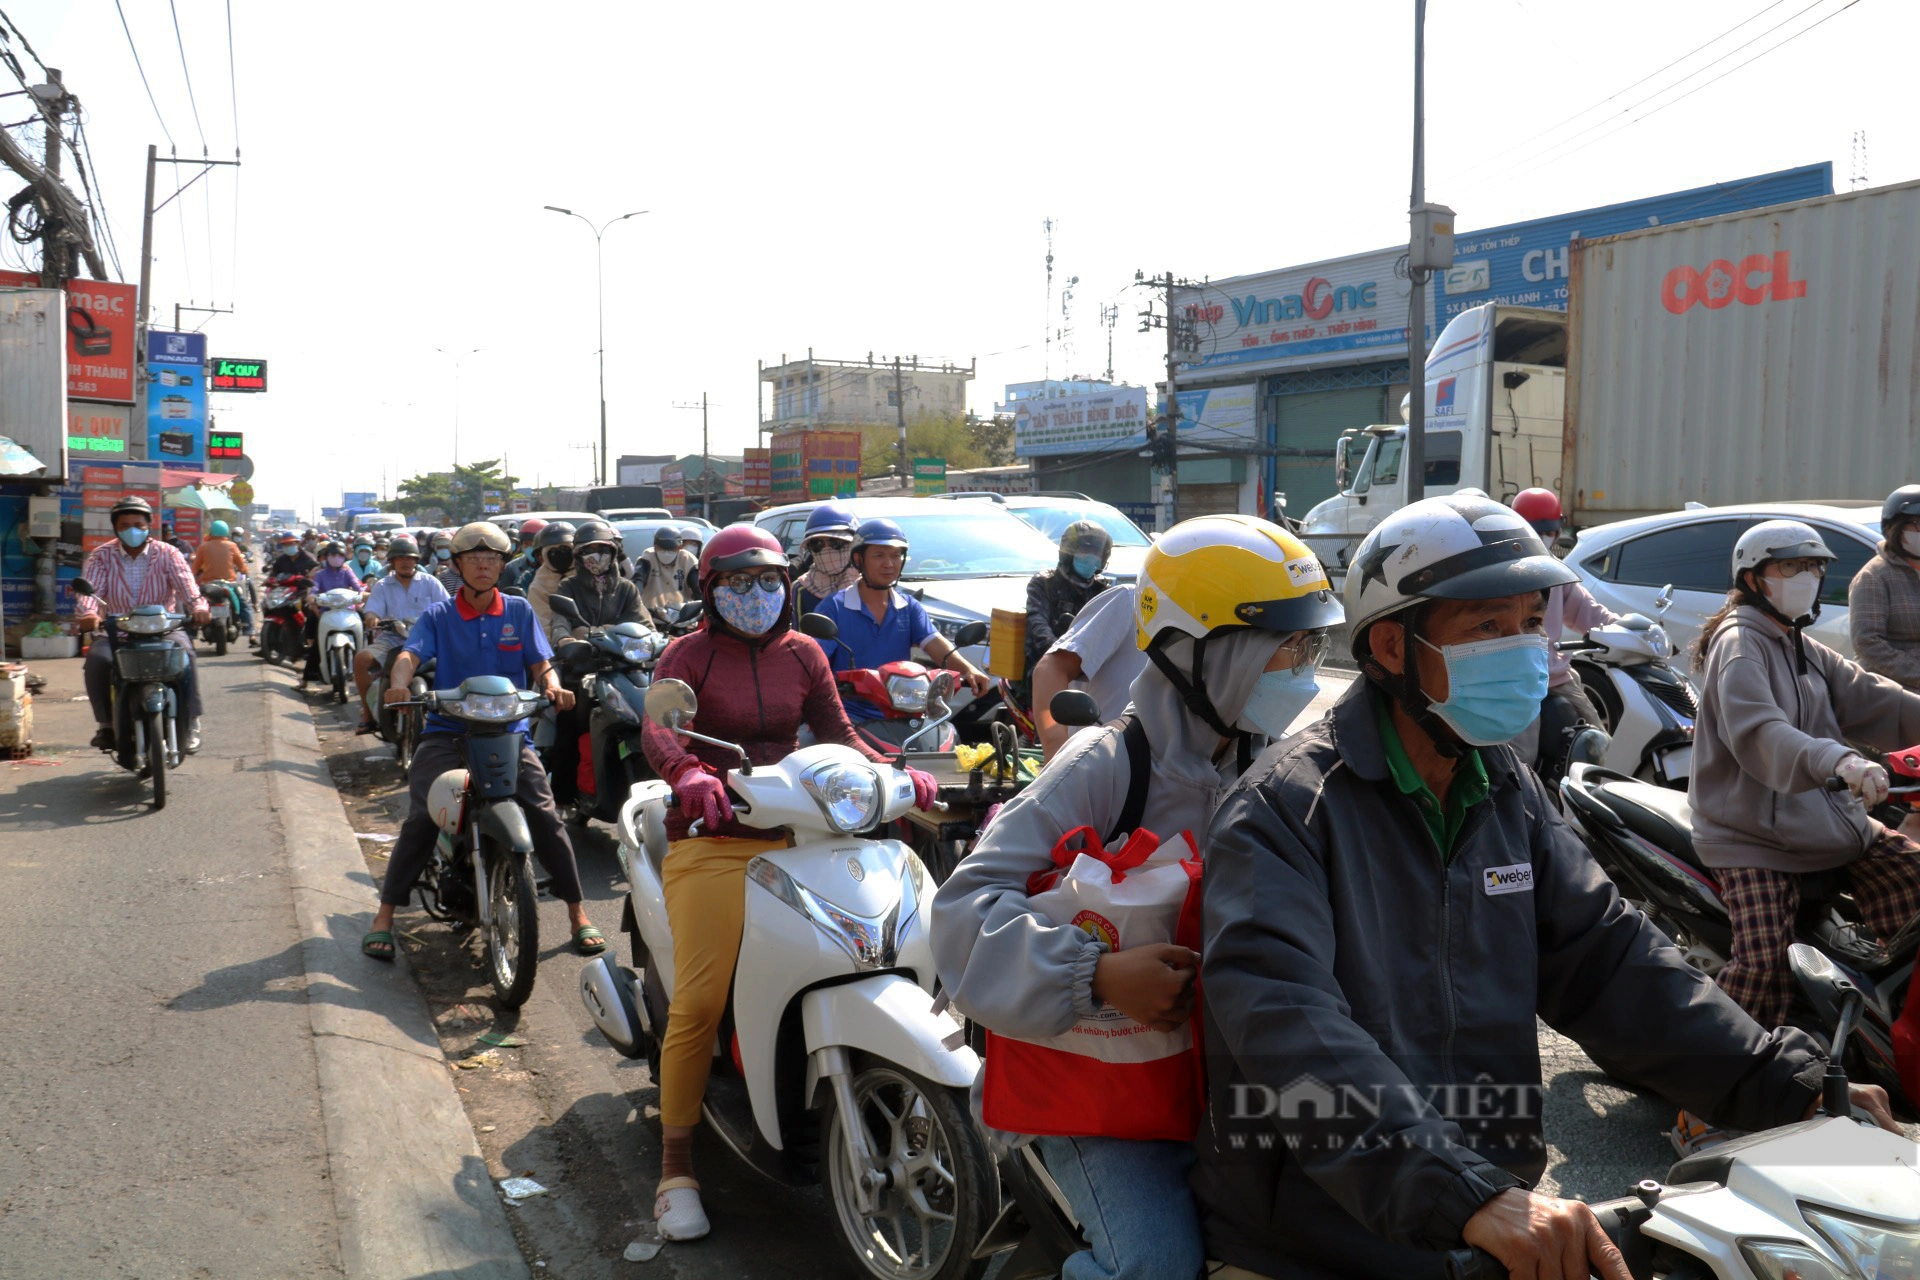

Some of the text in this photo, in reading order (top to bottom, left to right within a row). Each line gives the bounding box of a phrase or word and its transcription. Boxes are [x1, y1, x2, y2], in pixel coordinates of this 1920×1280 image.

[1522, 246, 1568, 282] CH
[1661, 250, 1807, 315] OOCL
[1434, 406, 1454, 416] SAFI
[90, 416, 122, 436] QUY
[1084, 1026, 1110, 1039] những
[1111, 1026, 1133, 1037] bước
